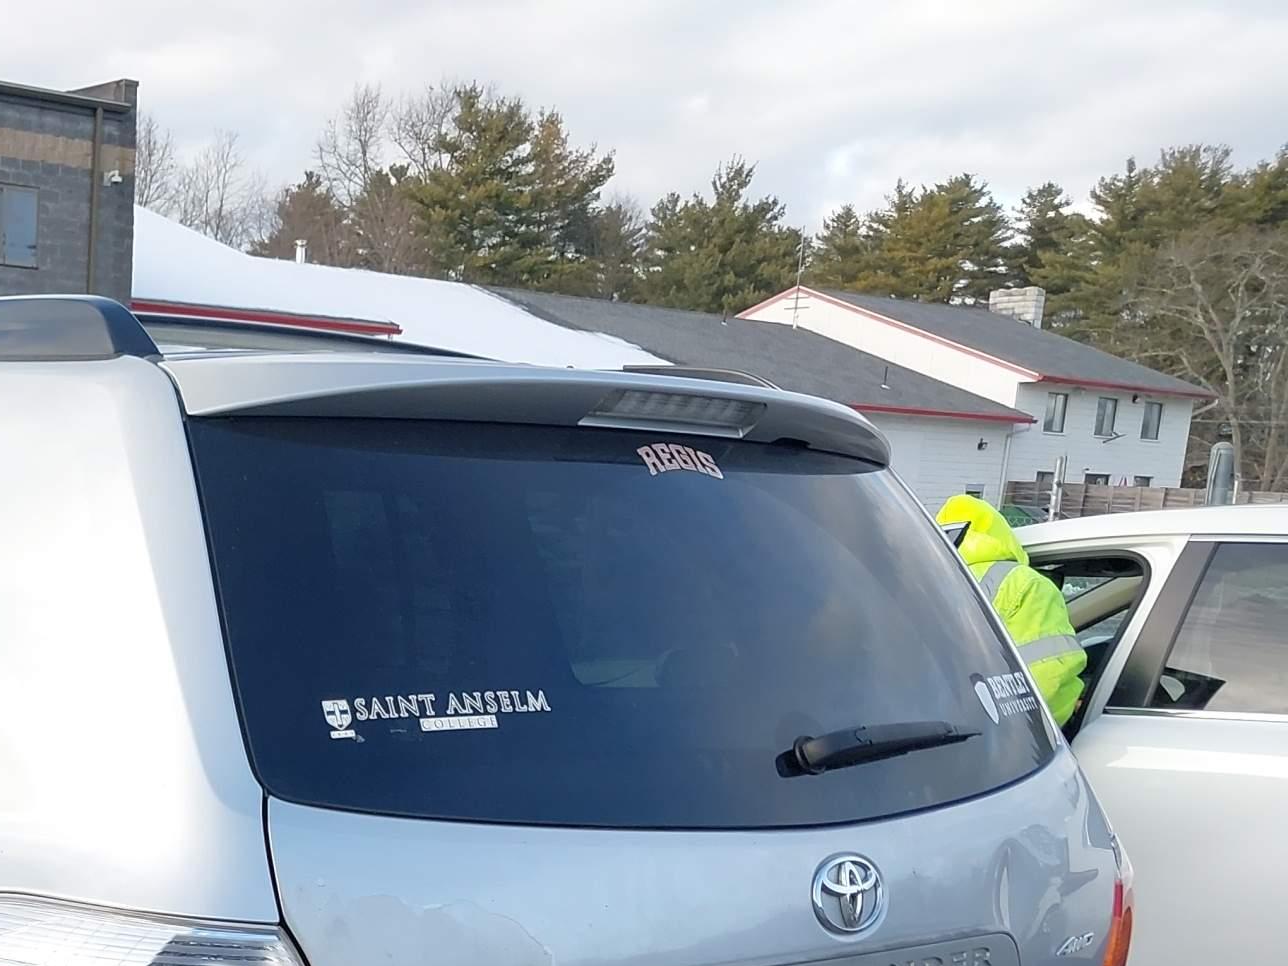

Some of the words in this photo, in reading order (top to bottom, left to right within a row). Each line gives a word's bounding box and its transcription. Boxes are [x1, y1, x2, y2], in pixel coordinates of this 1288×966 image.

[637, 443, 724, 480] REGIS
[987, 671, 1030, 700] BENTLEY
[354, 693, 436, 721] SAINT
[446, 689, 552, 715] ANSELM
[999, 696, 1039, 717] UNIVERSITY
[421, 716, 498, 731] COLLEGE
